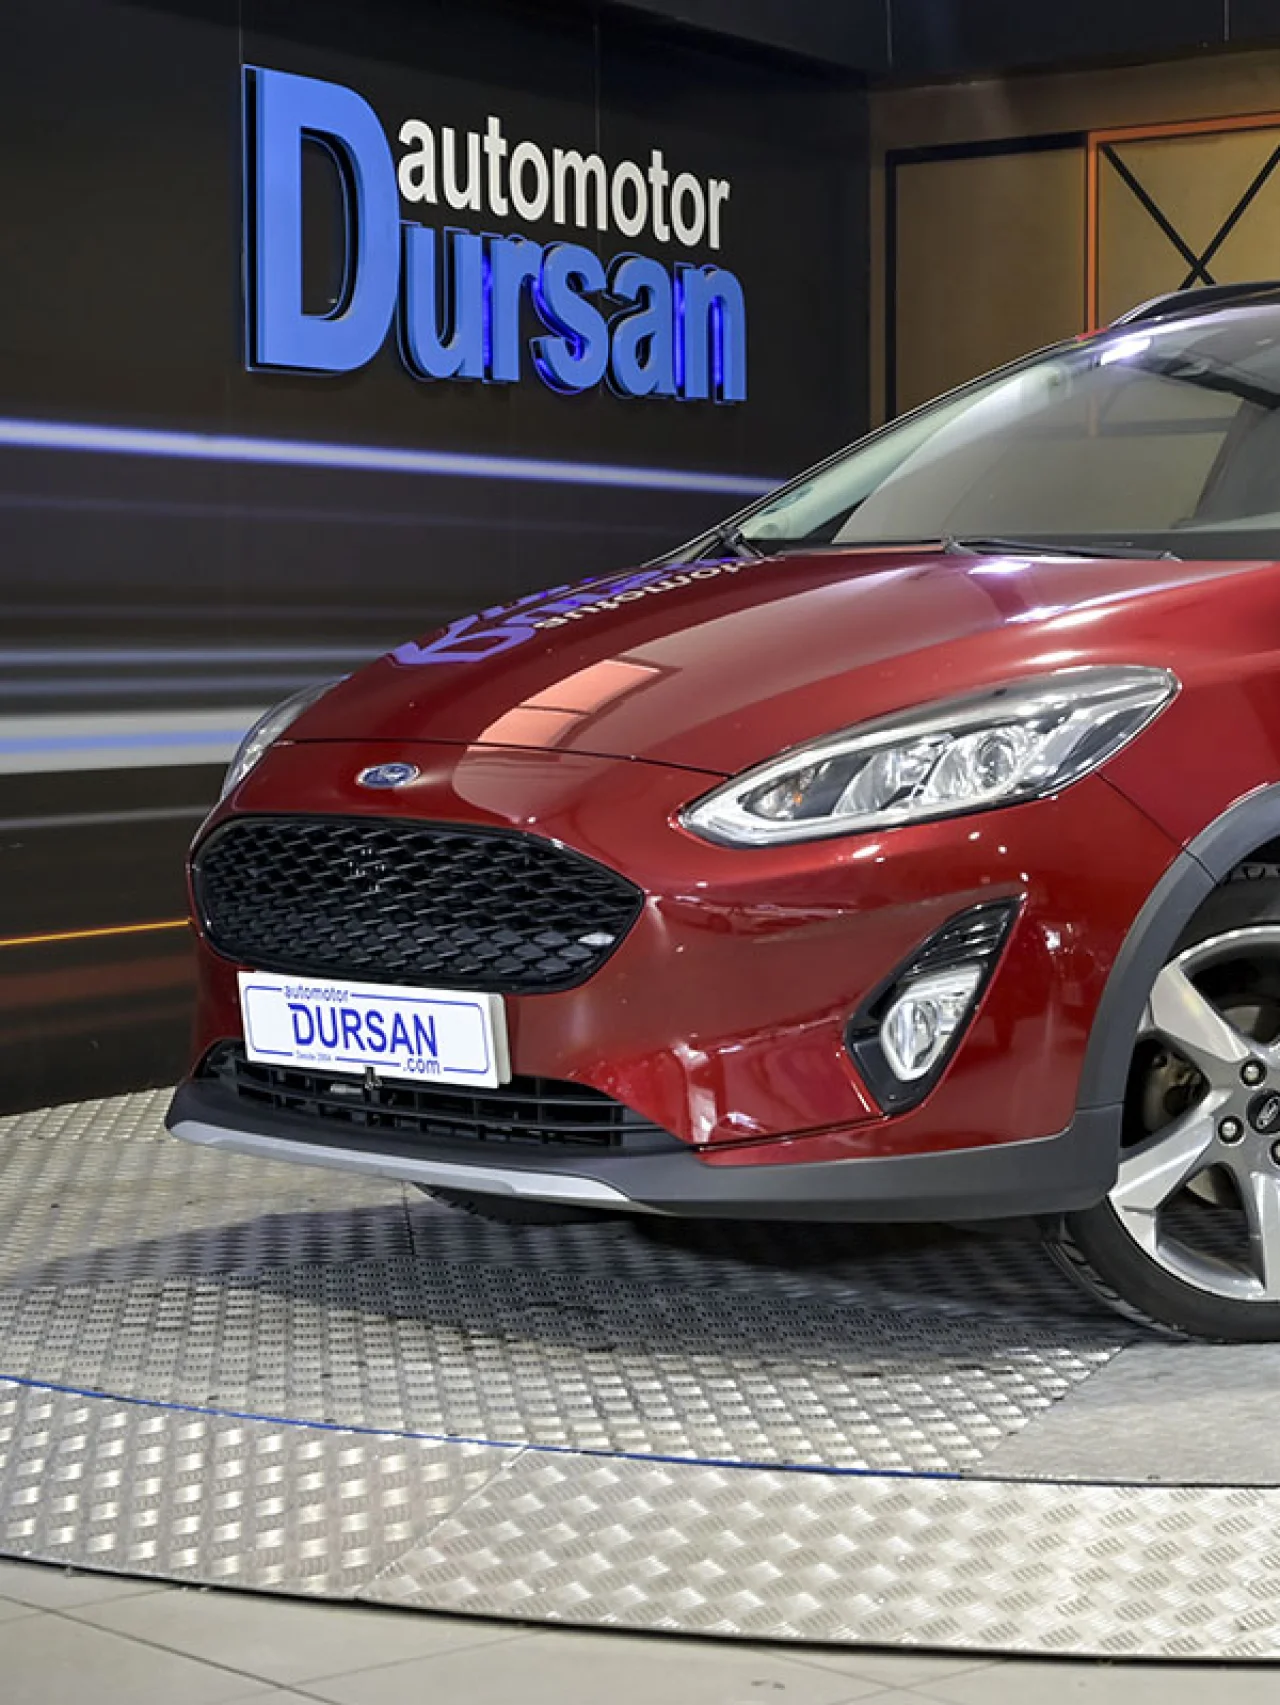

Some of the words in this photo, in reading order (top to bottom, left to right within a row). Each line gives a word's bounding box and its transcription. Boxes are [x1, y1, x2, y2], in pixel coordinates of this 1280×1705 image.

[398, 116, 731, 249] automotor
[243, 63, 747, 402] Dursan
[284, 985, 349, 1003] automotor
[288, 1003, 438, 1057] DURSAN
[403, 1058, 441, 1075] .com
